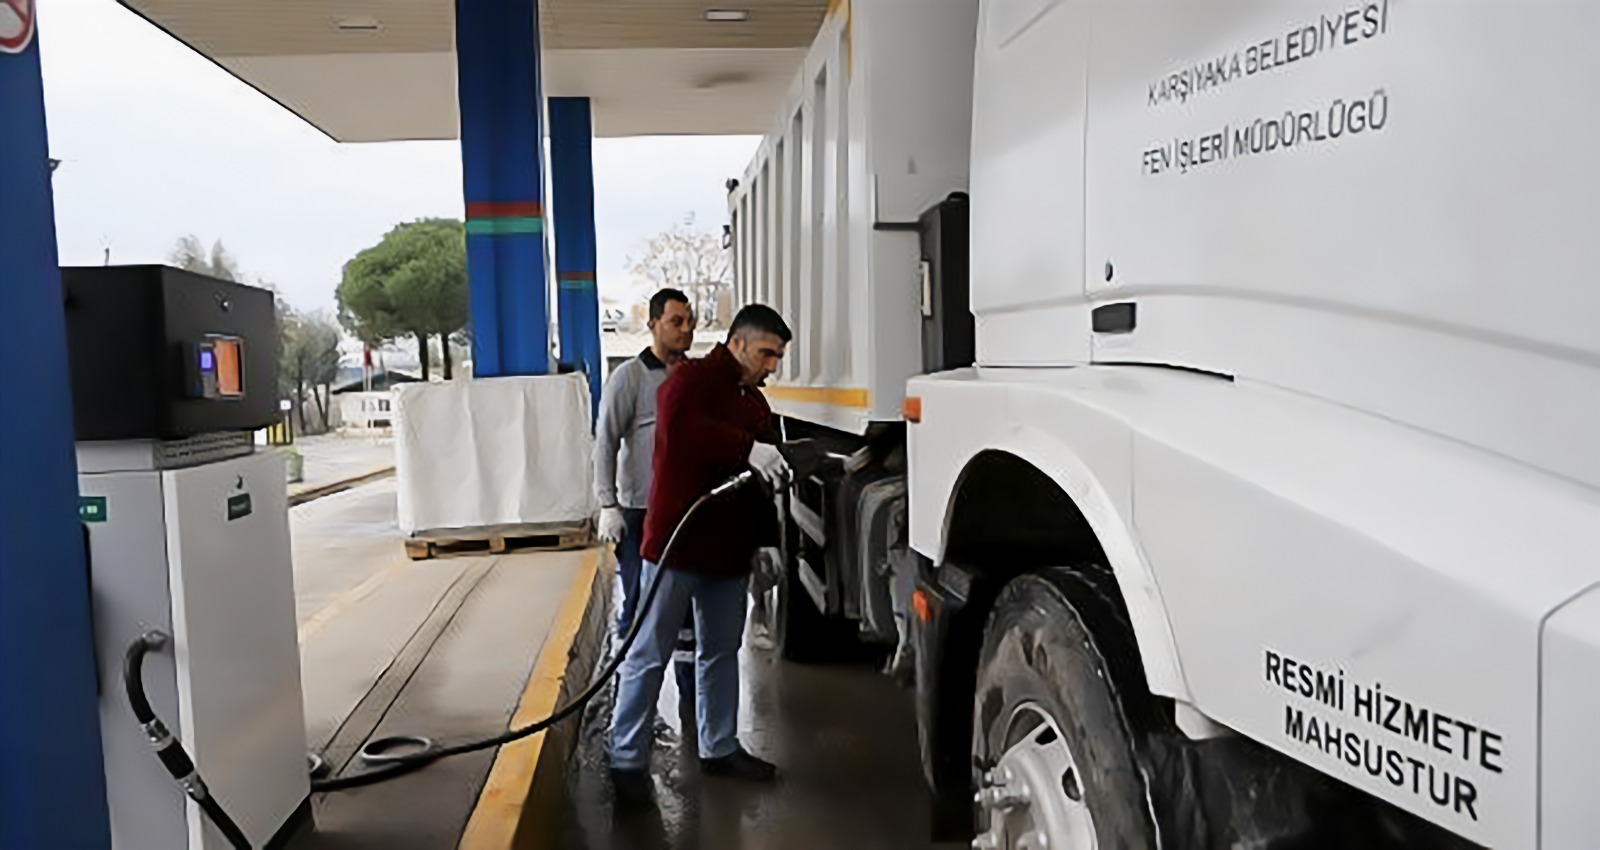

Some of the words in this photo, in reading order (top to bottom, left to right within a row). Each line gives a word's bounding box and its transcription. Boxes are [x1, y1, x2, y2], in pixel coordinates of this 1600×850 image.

[1147, 53, 1241, 107] KARŞIYAKA
[1141, 143, 1171, 175] FEN
[1266, 650, 1344, 711] RESMİ
[1354, 682, 1503, 774] HİZMETE
[1285, 705, 1478, 822] MAHSUSTUR
